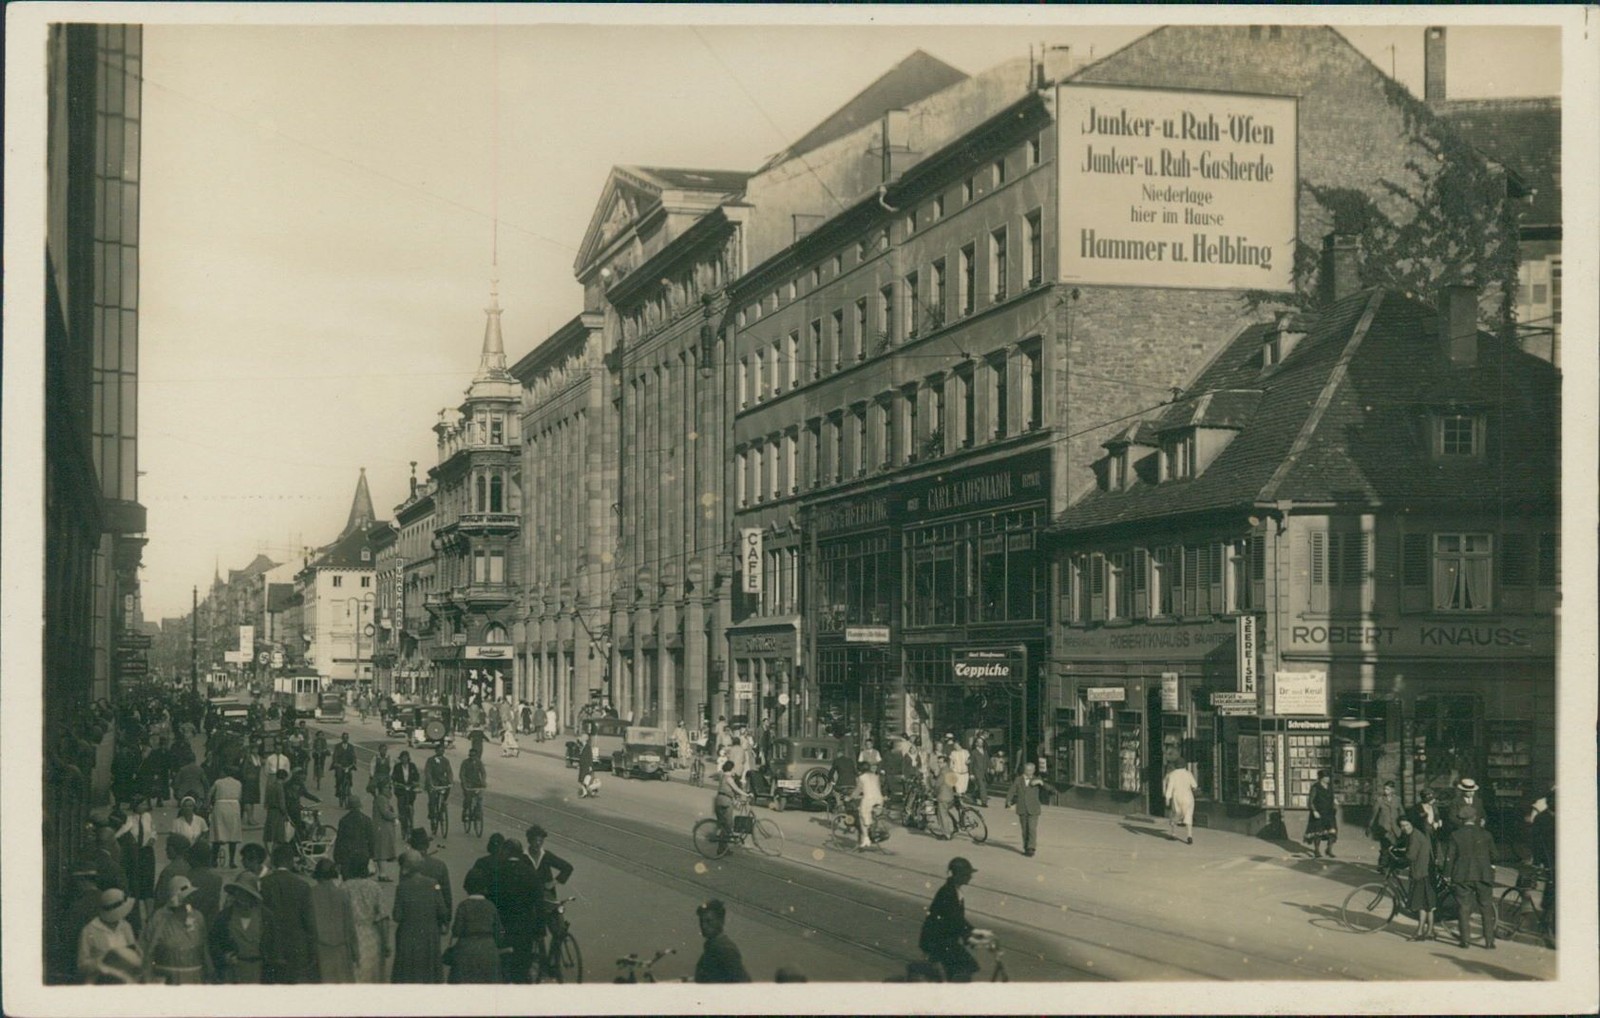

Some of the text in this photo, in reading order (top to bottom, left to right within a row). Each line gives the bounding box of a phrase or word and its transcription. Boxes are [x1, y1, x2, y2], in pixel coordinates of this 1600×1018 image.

[1160, 148, 1274, 182] Ruh-Gasherde
[1142, 184, 1213, 206] Niederlage
[1130, 205, 1224, 226] hier im Hause
[1081, 228, 1272, 271] Hammer u. Helbling
[1109, 633, 1147, 649] ROBERT
[1148, 631, 1190, 648] KNAUSS
[1292, 625, 1531, 647] ROBERT KNAUSS
[1244, 616, 1254, 692] SEEREISEN
[954, 662, 1010, 679] Teppiche
